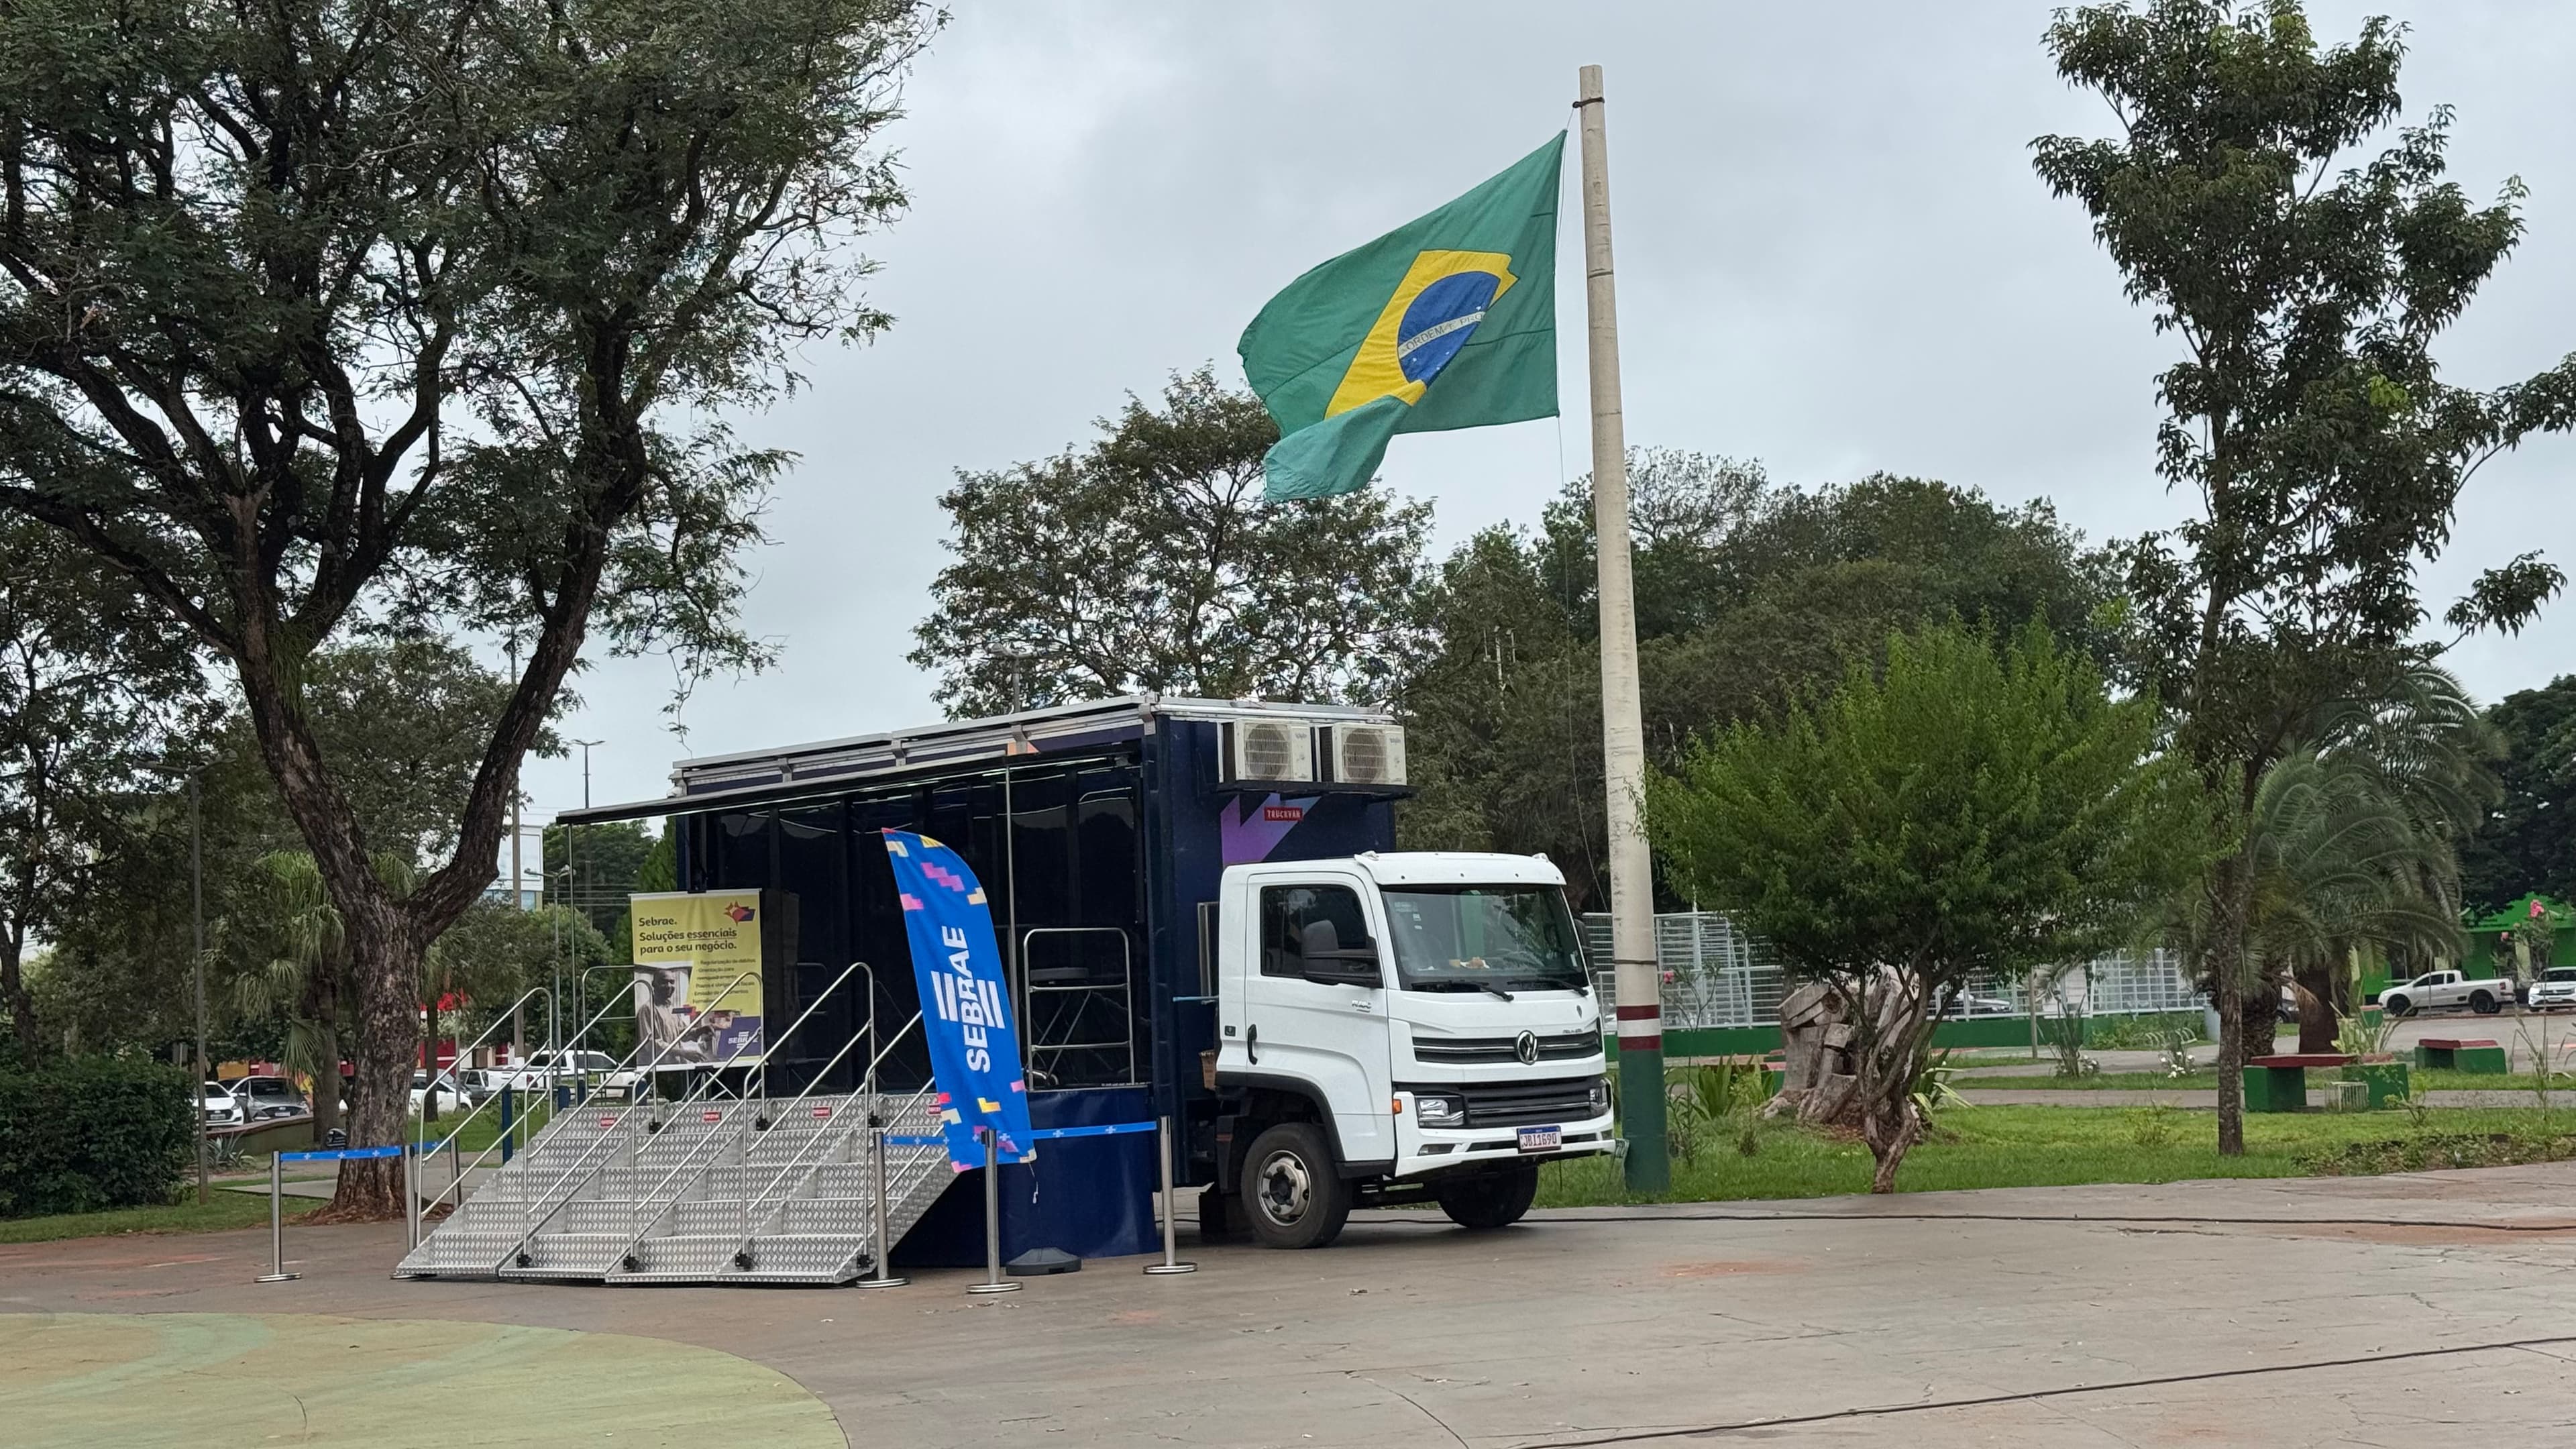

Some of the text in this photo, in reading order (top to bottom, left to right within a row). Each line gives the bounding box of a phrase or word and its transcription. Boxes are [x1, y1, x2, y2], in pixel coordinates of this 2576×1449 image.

[1406, 325, 1445, 350] ORDEM
[639, 916, 677, 926] Sebrae.
[639, 927, 737, 943] Soluções essenciais
[640, 945, 664, 956] para
[675, 944, 692, 952] seu
[695, 940, 737, 953] negócio.
[941, 926, 991, 1073] SEBRAE
